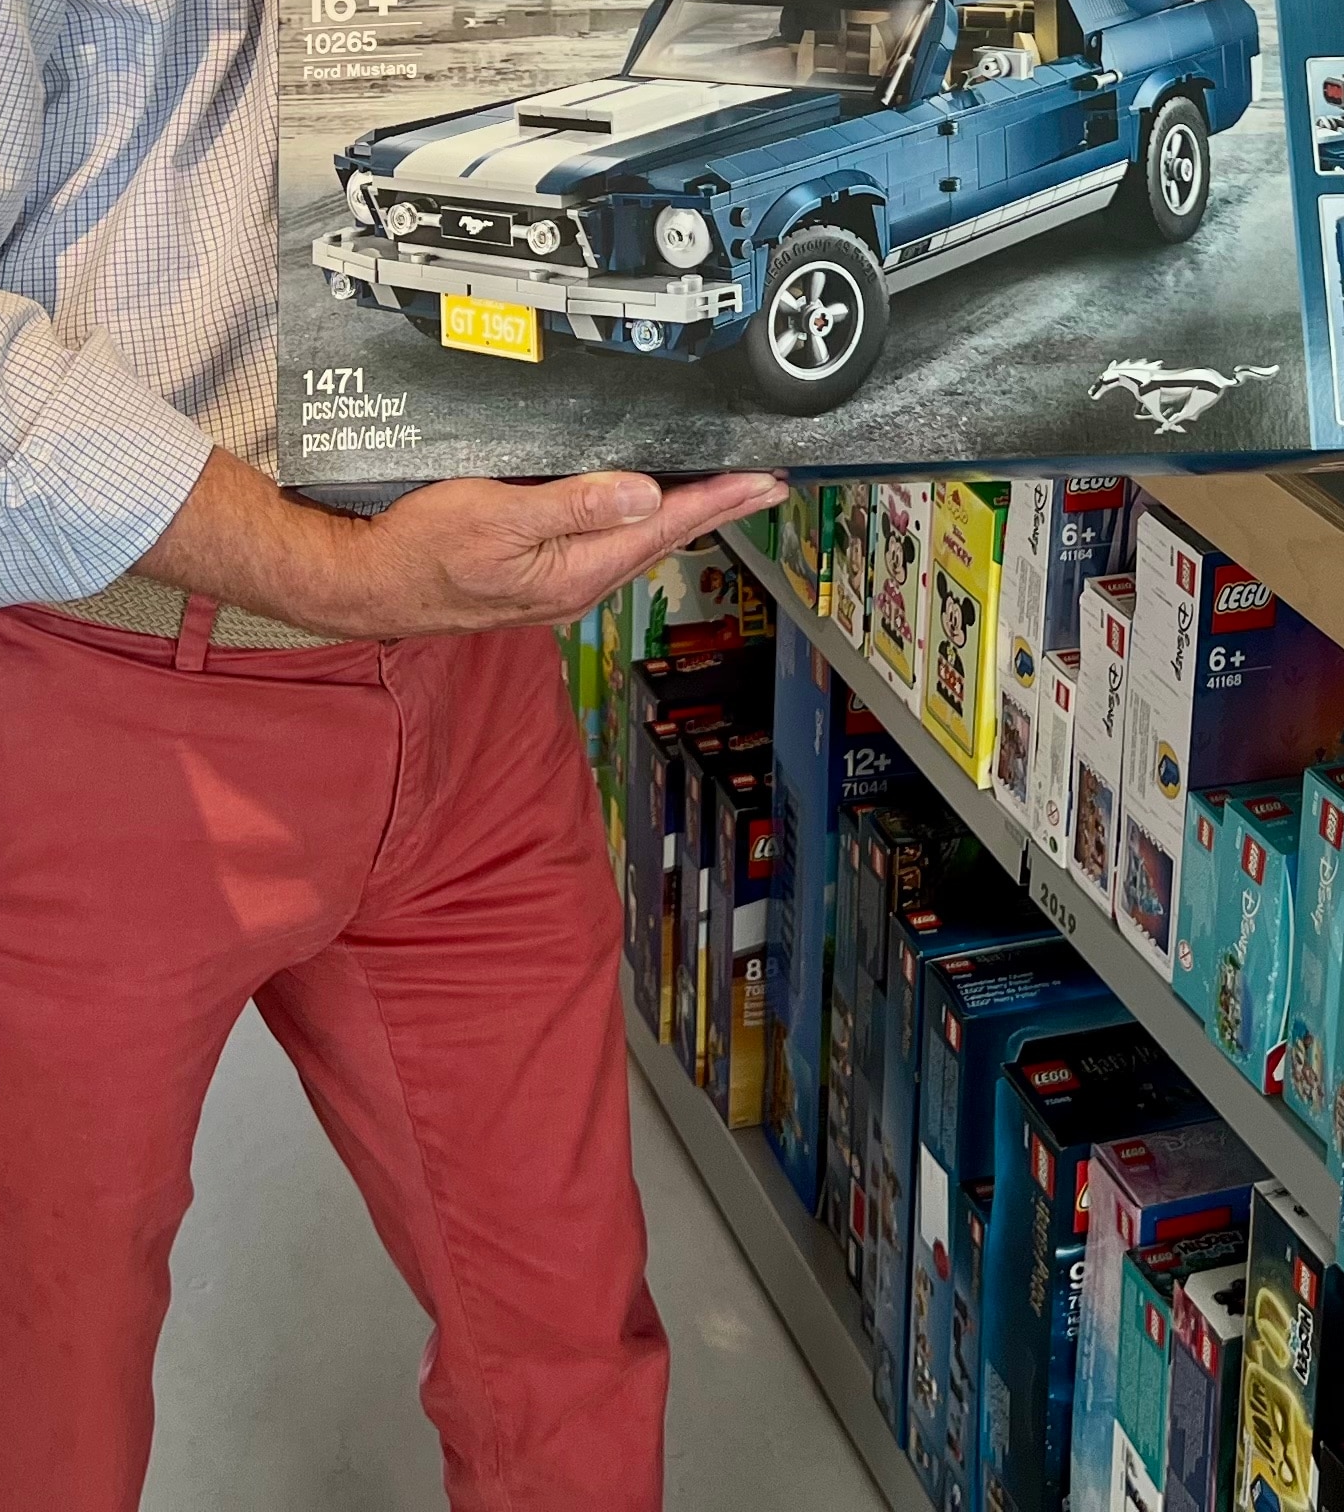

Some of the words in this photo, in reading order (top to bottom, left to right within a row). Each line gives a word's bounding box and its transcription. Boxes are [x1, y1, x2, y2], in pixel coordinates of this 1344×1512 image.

[303, 31, 378, 55] 10265
[303, 64, 341, 79] Ford
[345, 63, 418, 79] Mustang
[792, 239, 832, 257] Group
[451, 306, 476, 337] GT
[481, 305, 526, 345] 1967
[303, 368, 365, 396] 1471
[302, 393, 408, 425] pcs/Stck/pz/
[302, 425, 423, 457] pzs/db/det/件
[1027, 483, 1049, 556] Disney
[1061, 524, 1096, 545] 6+
[1059, 549, 1093, 562] 41164
[1182, 555, 1195, 591] LEGO
[1215, 582, 1272, 614] LEGO
[1111, 620, 1123, 655] LEGO
[1175, 601, 1195, 681] Disney
[1209, 648, 1246, 673] 6+
[1206, 673, 1242, 688] 41168
[1100, 661, 1124, 739] Disney
[843, 749, 892, 777] 12+
[842, 780, 888, 797] 71044
[1325, 803, 1342, 846] LEGO
[1246, 839, 1262, 880] LEGO
[1040, 883, 1078, 934] 2019
[1313, 856, 1340, 936] Disney
[913, 915, 936, 924] LEGO
[1233, 890, 1261, 963] Disney
[1033, 1068, 1071, 1086] LEGO
[1121, 1147, 1147, 1159] LEGO
[1146, 1251, 1174, 1264] LEGO
[1294, 1304, 1313, 1383] HIDDEN
